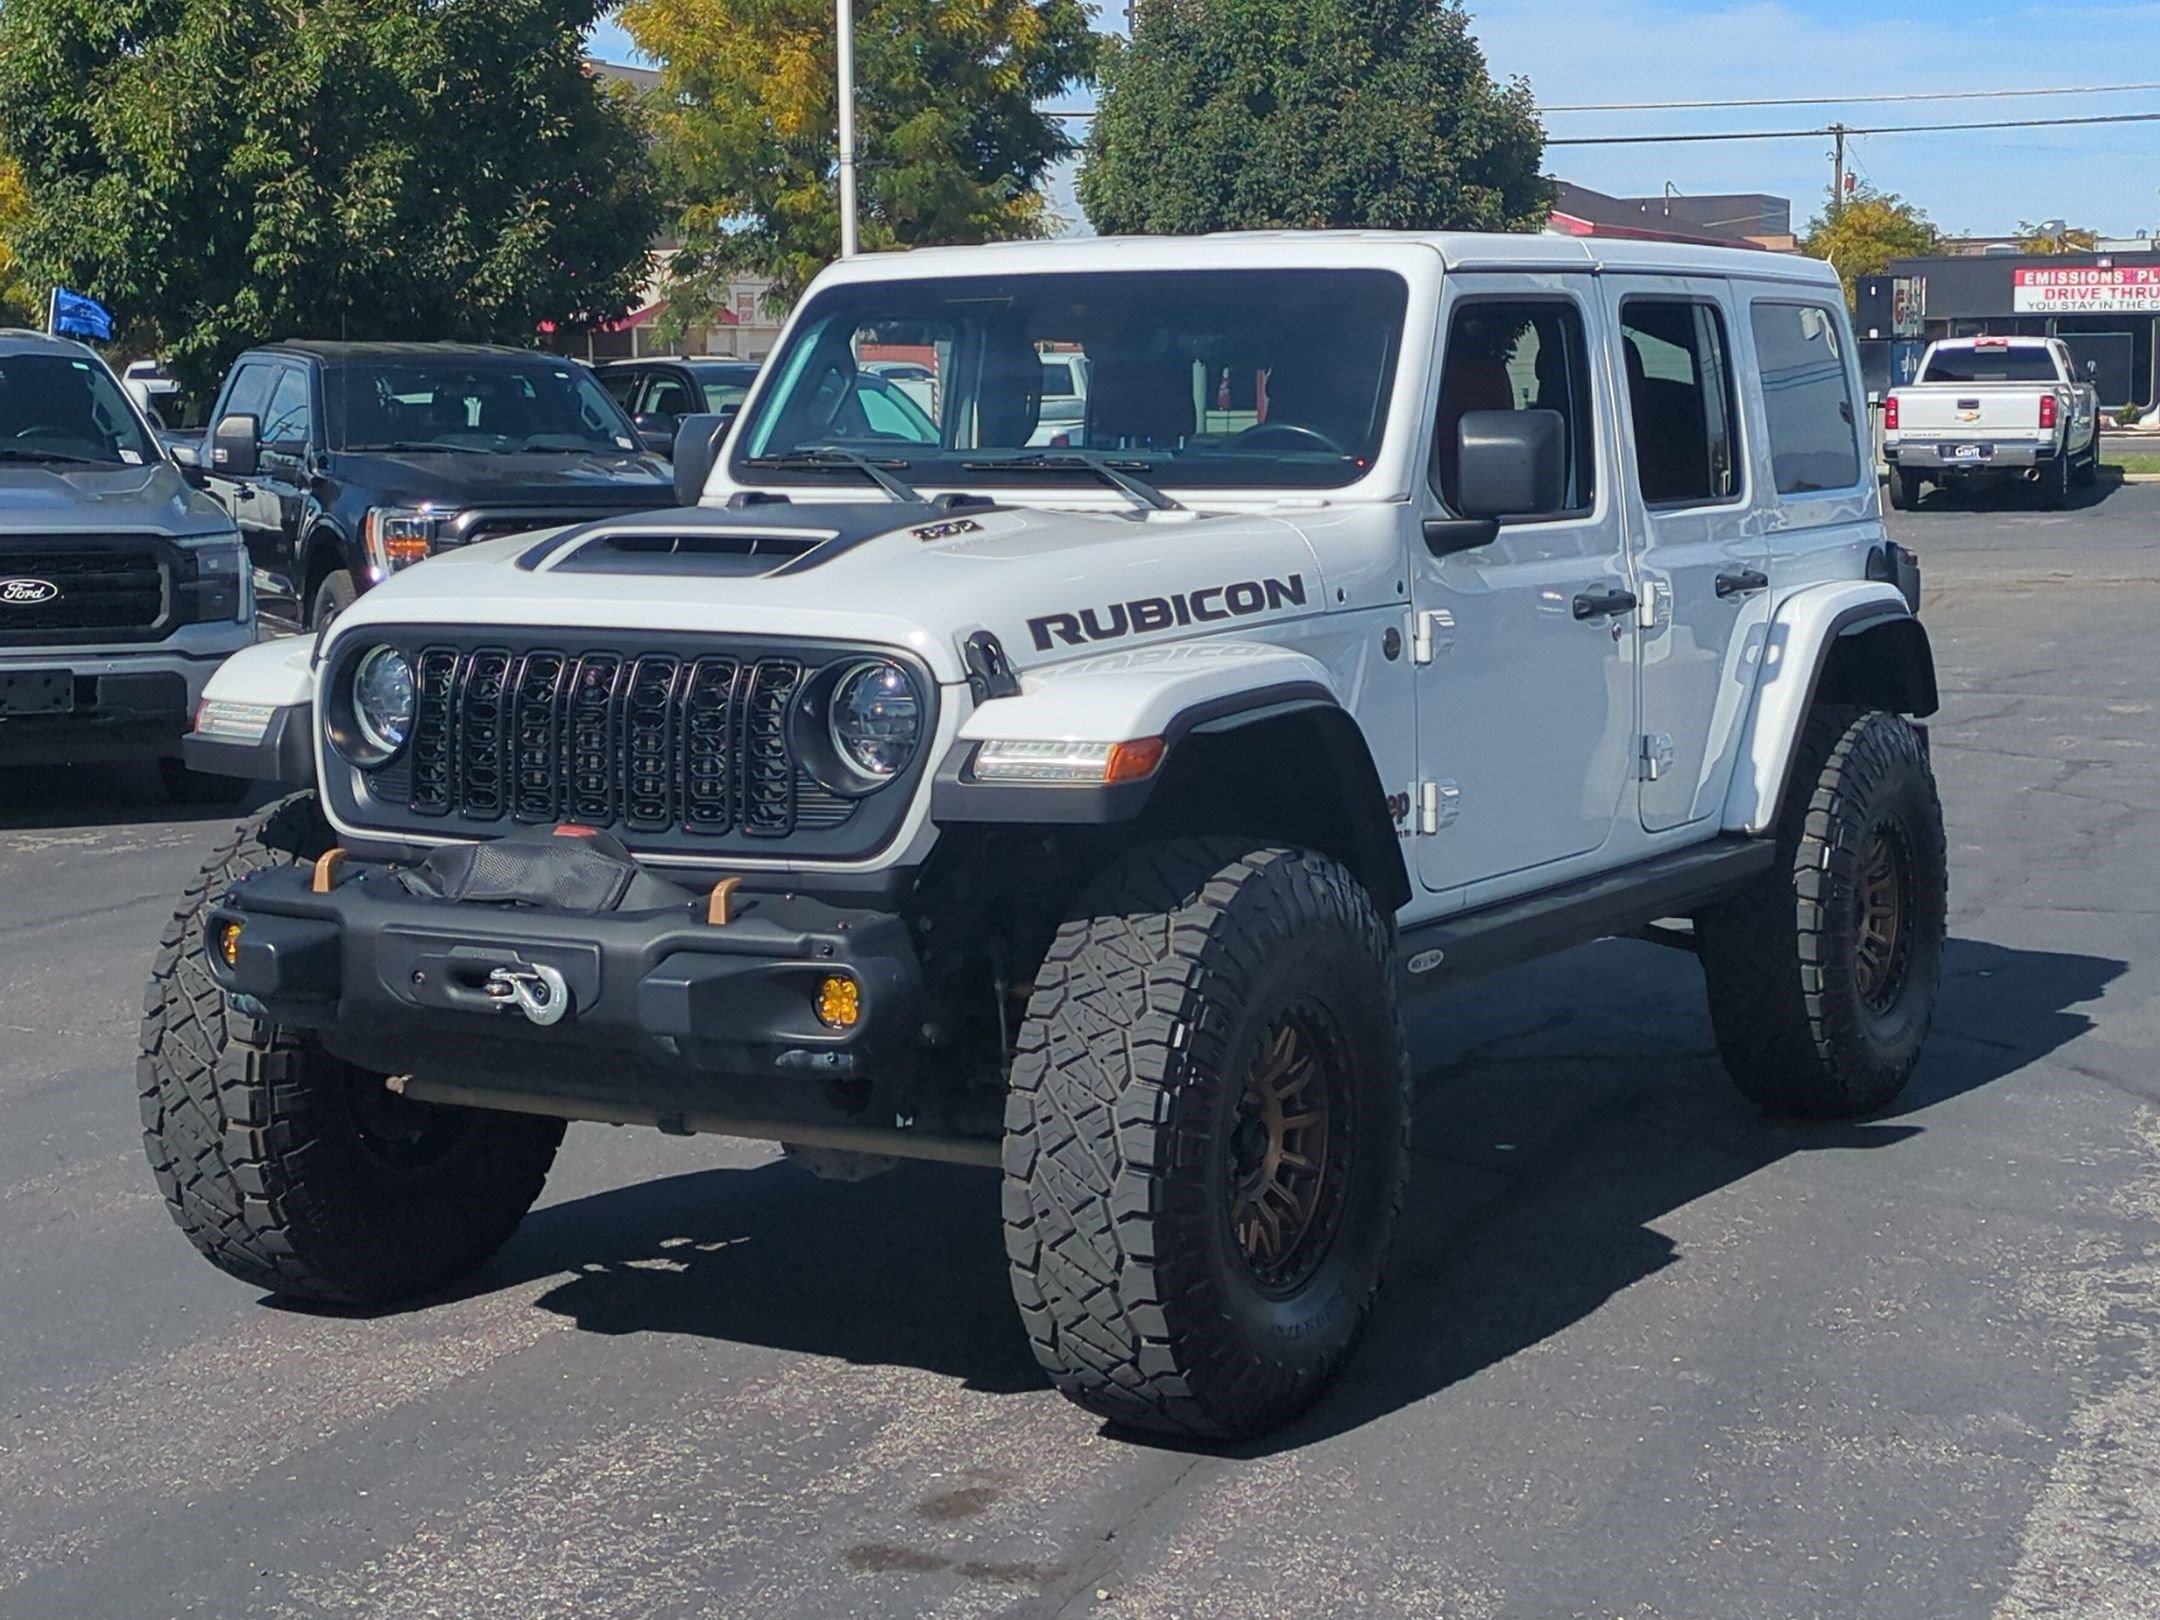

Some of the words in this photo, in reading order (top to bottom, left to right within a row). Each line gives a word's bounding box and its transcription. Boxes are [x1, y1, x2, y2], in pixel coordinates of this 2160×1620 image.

[2024, 270, 2124, 284] EMISSIONS
[2045, 287, 2101, 299] DRIVE
[2109, 286, 2160, 299] THRU
[2028, 302, 2056, 311] YOU
[2061, 301, 2096, 310] STAY
[2099, 301, 2113, 309] IN
[2117, 300, 2144, 309] THE
[4, 583, 45, 599] Ford
[1026, 574, 1307, 651] RUBICON
